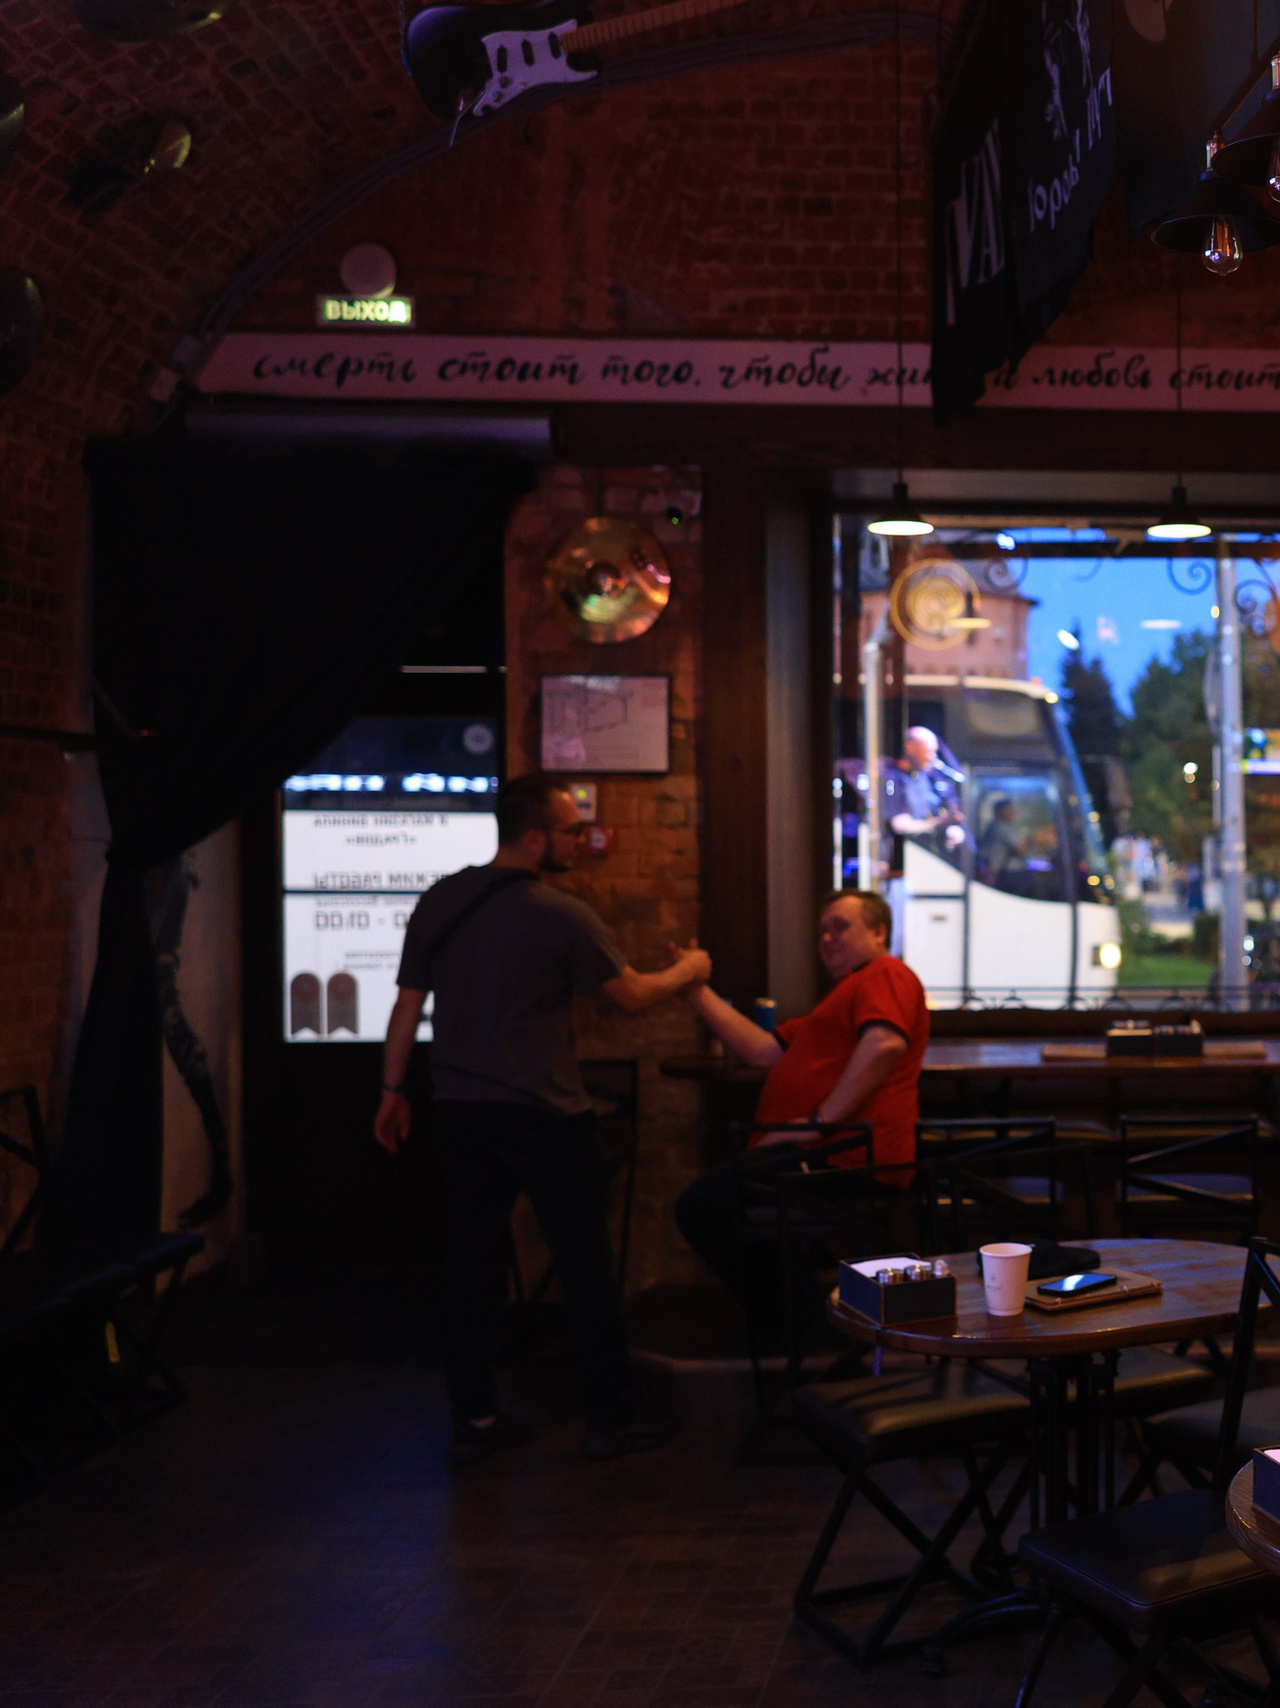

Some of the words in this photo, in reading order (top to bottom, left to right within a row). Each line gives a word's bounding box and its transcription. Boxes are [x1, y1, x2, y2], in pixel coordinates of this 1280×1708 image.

[325, 299, 408, 323] ВЫХОД
[253, 351, 416, 388] смерть
[438, 351, 581, 385] стоит
[719, 345, 850, 391] чтобы
[1032, 349, 1153, 388] любовь
